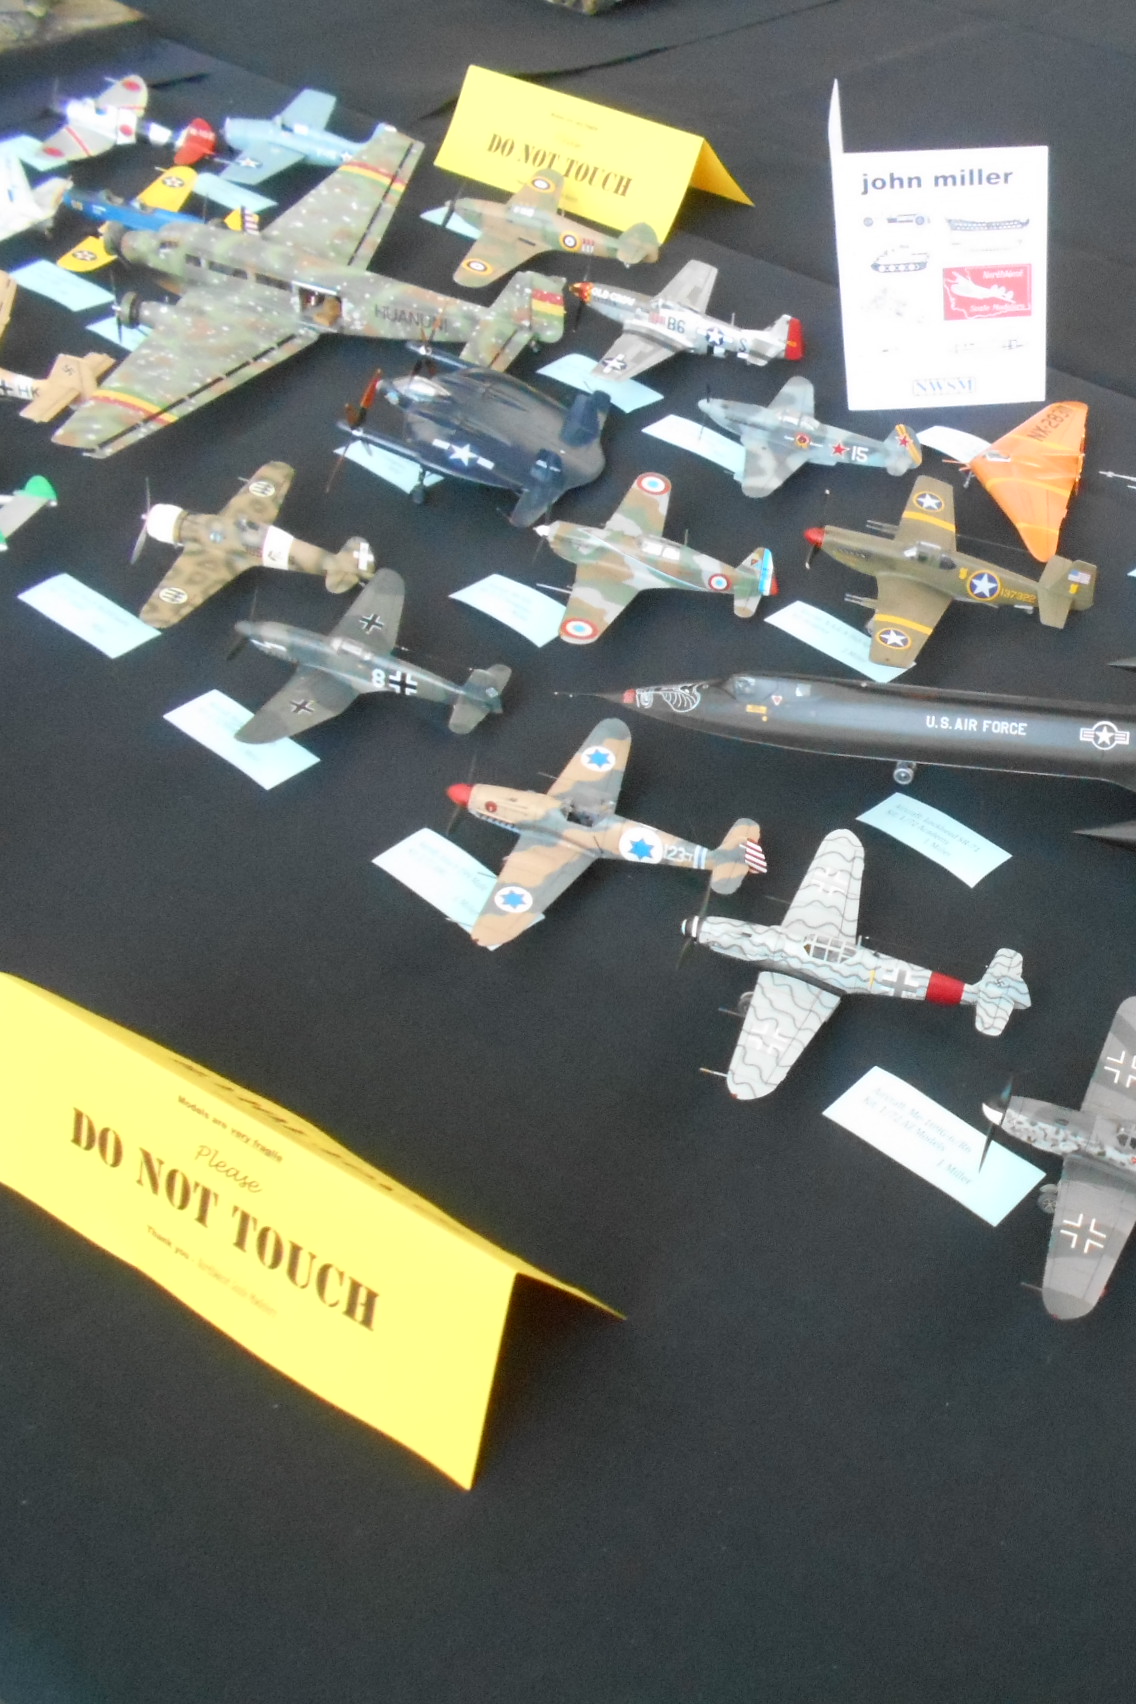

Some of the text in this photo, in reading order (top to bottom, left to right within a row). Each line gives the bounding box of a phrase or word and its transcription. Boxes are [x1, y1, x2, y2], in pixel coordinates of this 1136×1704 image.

[487, 133, 632, 197] DO NOT TOUCH
[861, 168, 1013, 195] john miller
[667, 316, 685, 334] B6
[916, 379, 975, 393] NWSM
[851, 445, 869, 463] 15
[371, 668, 386, 688] 8
[926, 715, 1028, 736] U.S. AIR FORCE
[178, 1094, 284, 1164] Models are very fragile
[194, 1144, 263, 1194] Please
[71, 1107, 123, 1168] DO
[136, 1147, 219, 1229] NOT
[232, 1205, 380, 1332] TOUCH
[147, 1224, 173, 1249] Thank
